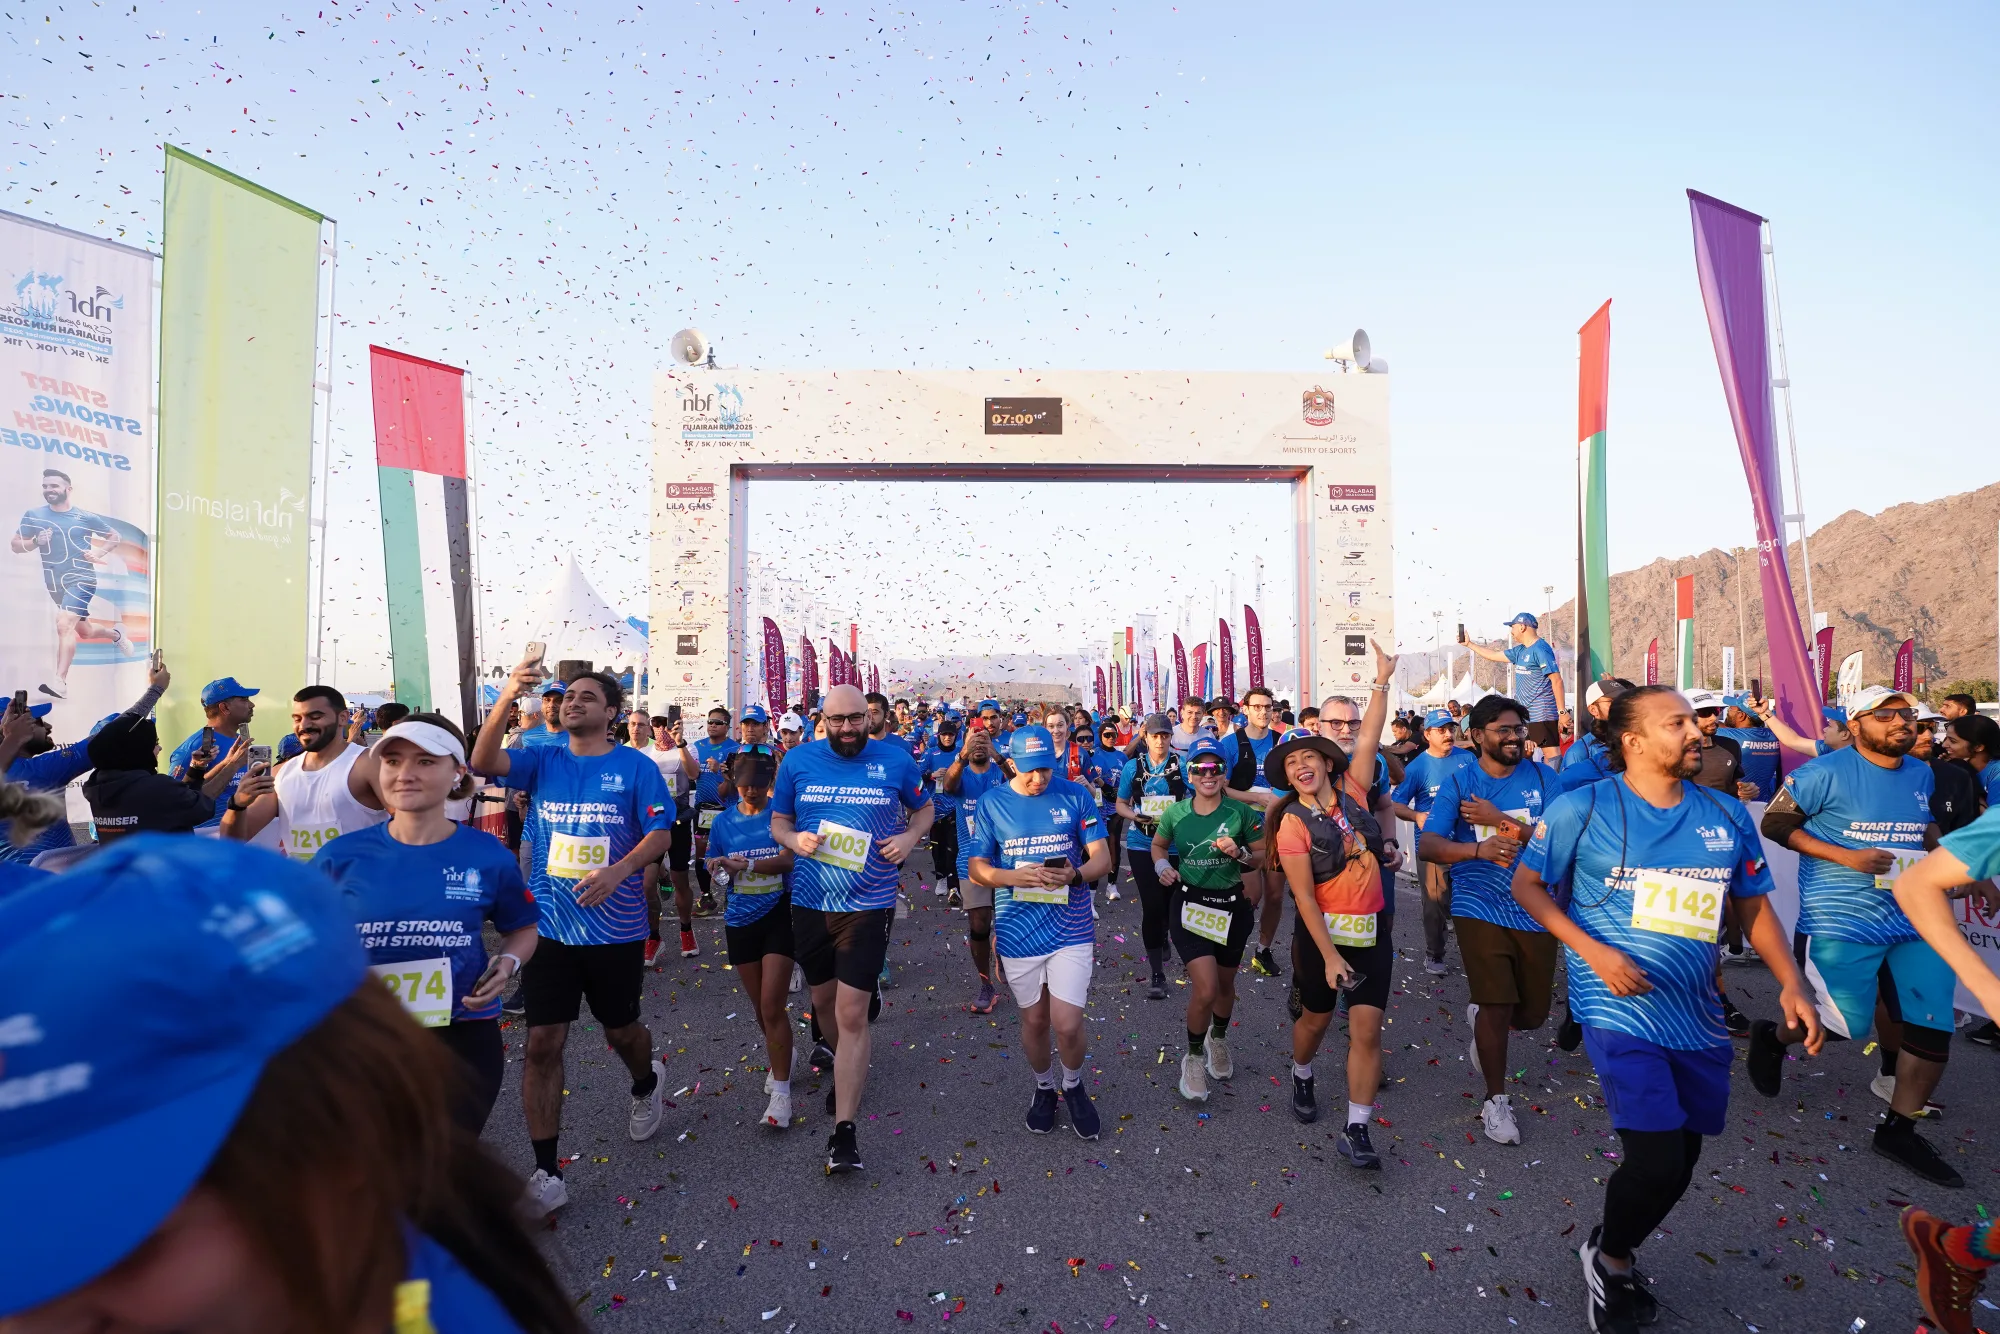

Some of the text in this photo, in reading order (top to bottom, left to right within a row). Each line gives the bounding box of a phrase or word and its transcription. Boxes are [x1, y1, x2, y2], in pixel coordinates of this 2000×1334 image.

[683, 393, 714, 412] nbf
[992, 414, 1034, 424] 07:00
[1352, 504, 1374, 513] GMS
[1742, 740, 1780, 750] FINISHE
[804, 786, 884, 796] START STRONG,
[800, 794, 891, 806] FINISH STRONGER
[572, 802, 618, 814] STRONG,
[566, 814, 624, 824] STRONGER
[1850, 822, 1928, 832] START STRON
[1004, 834, 1068, 848] START STRONG,
[1842, 830, 1889, 842] FINISH
[822, 828, 866, 858] 7003
[1028, 841, 1073, 854] STRONGER
[554, 840, 606, 864] 7159
[750, 847, 778, 856] STRON
[446, 872, 466, 882] nbf
[1644, 882, 1716, 920] 7142
[1186, 907, 1228, 932] 7258
[1328, 913, 1374, 934] 7266
[354, 920, 464, 934] TART STRONG,
[390, 935, 472, 948] STRONGER
[382, 970, 446, 1002] 274
